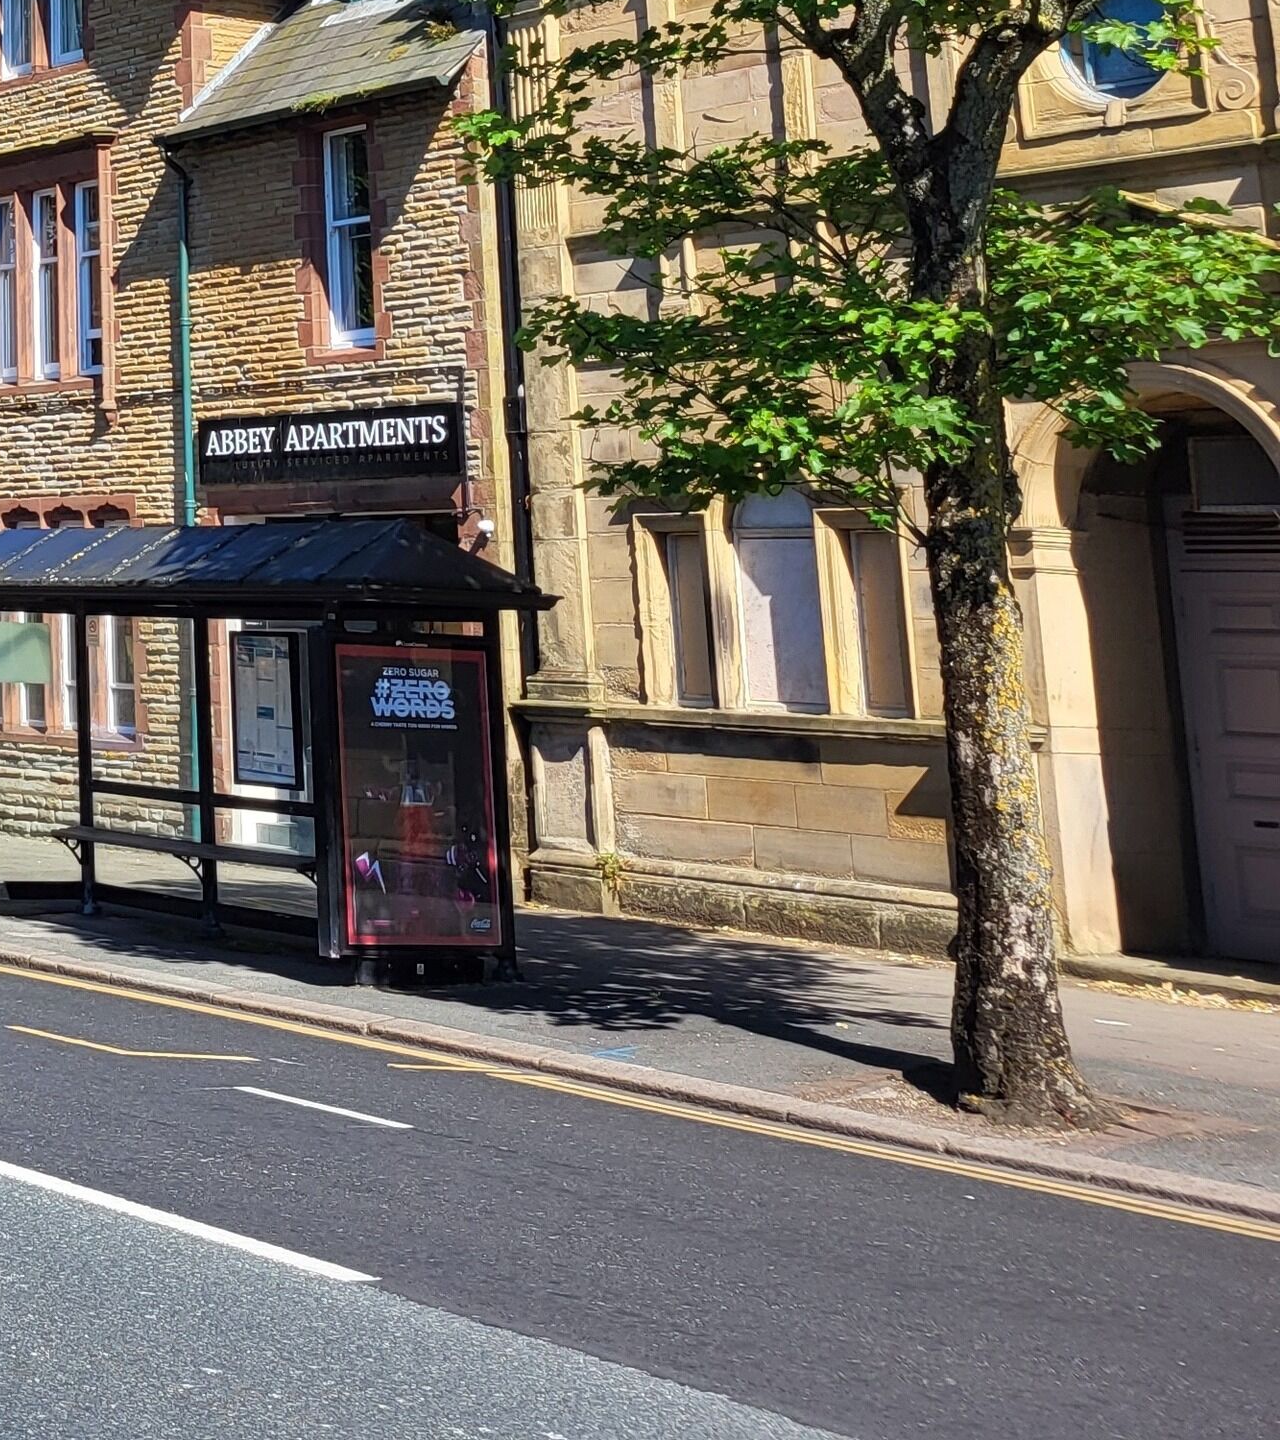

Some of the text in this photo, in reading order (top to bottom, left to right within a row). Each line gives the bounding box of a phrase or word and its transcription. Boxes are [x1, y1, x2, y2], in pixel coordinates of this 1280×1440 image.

[205, 415, 448, 457] ABBEY APARTMENTS
[235, 450, 449, 470] LUXURY SERVICED APARTMENTS
[382, 666, 440, 678] ZERO SUGAR
[374, 678, 451, 700] #ZERO
[370, 696, 455, 720] WORDS
